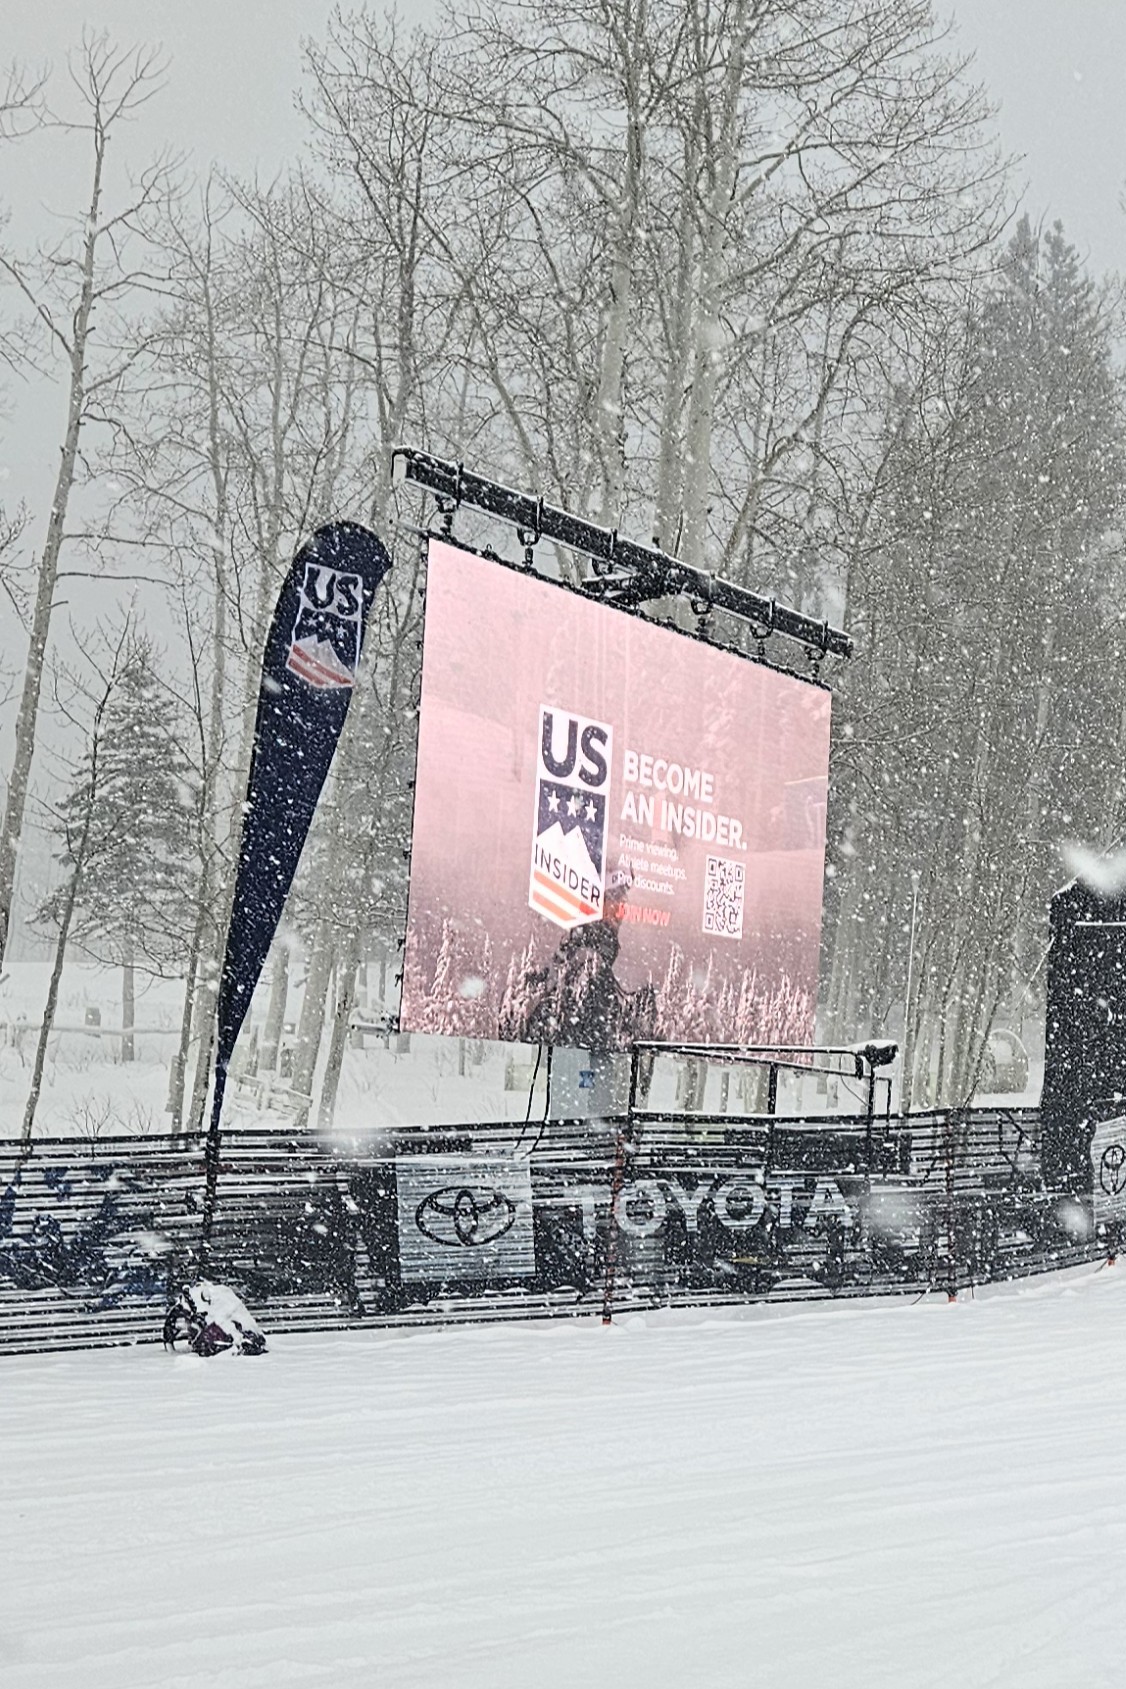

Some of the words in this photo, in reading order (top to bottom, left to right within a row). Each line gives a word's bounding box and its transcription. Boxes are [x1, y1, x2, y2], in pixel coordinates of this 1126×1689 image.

[304, 566, 359, 616] US
[541, 711, 609, 787] US
[623, 750, 714, 803] BECOME
[619, 833, 645, 853] Prime
[620, 791, 654, 827] AN
[660, 799, 748, 851] INSIDER.
[534, 844, 601, 907] INSIDER
[618, 853, 649, 872] Athlete
[618, 871, 632, 887] Pro
[642, 906, 671, 927] NOW
[572, 1177, 857, 1241] TOYOTA
